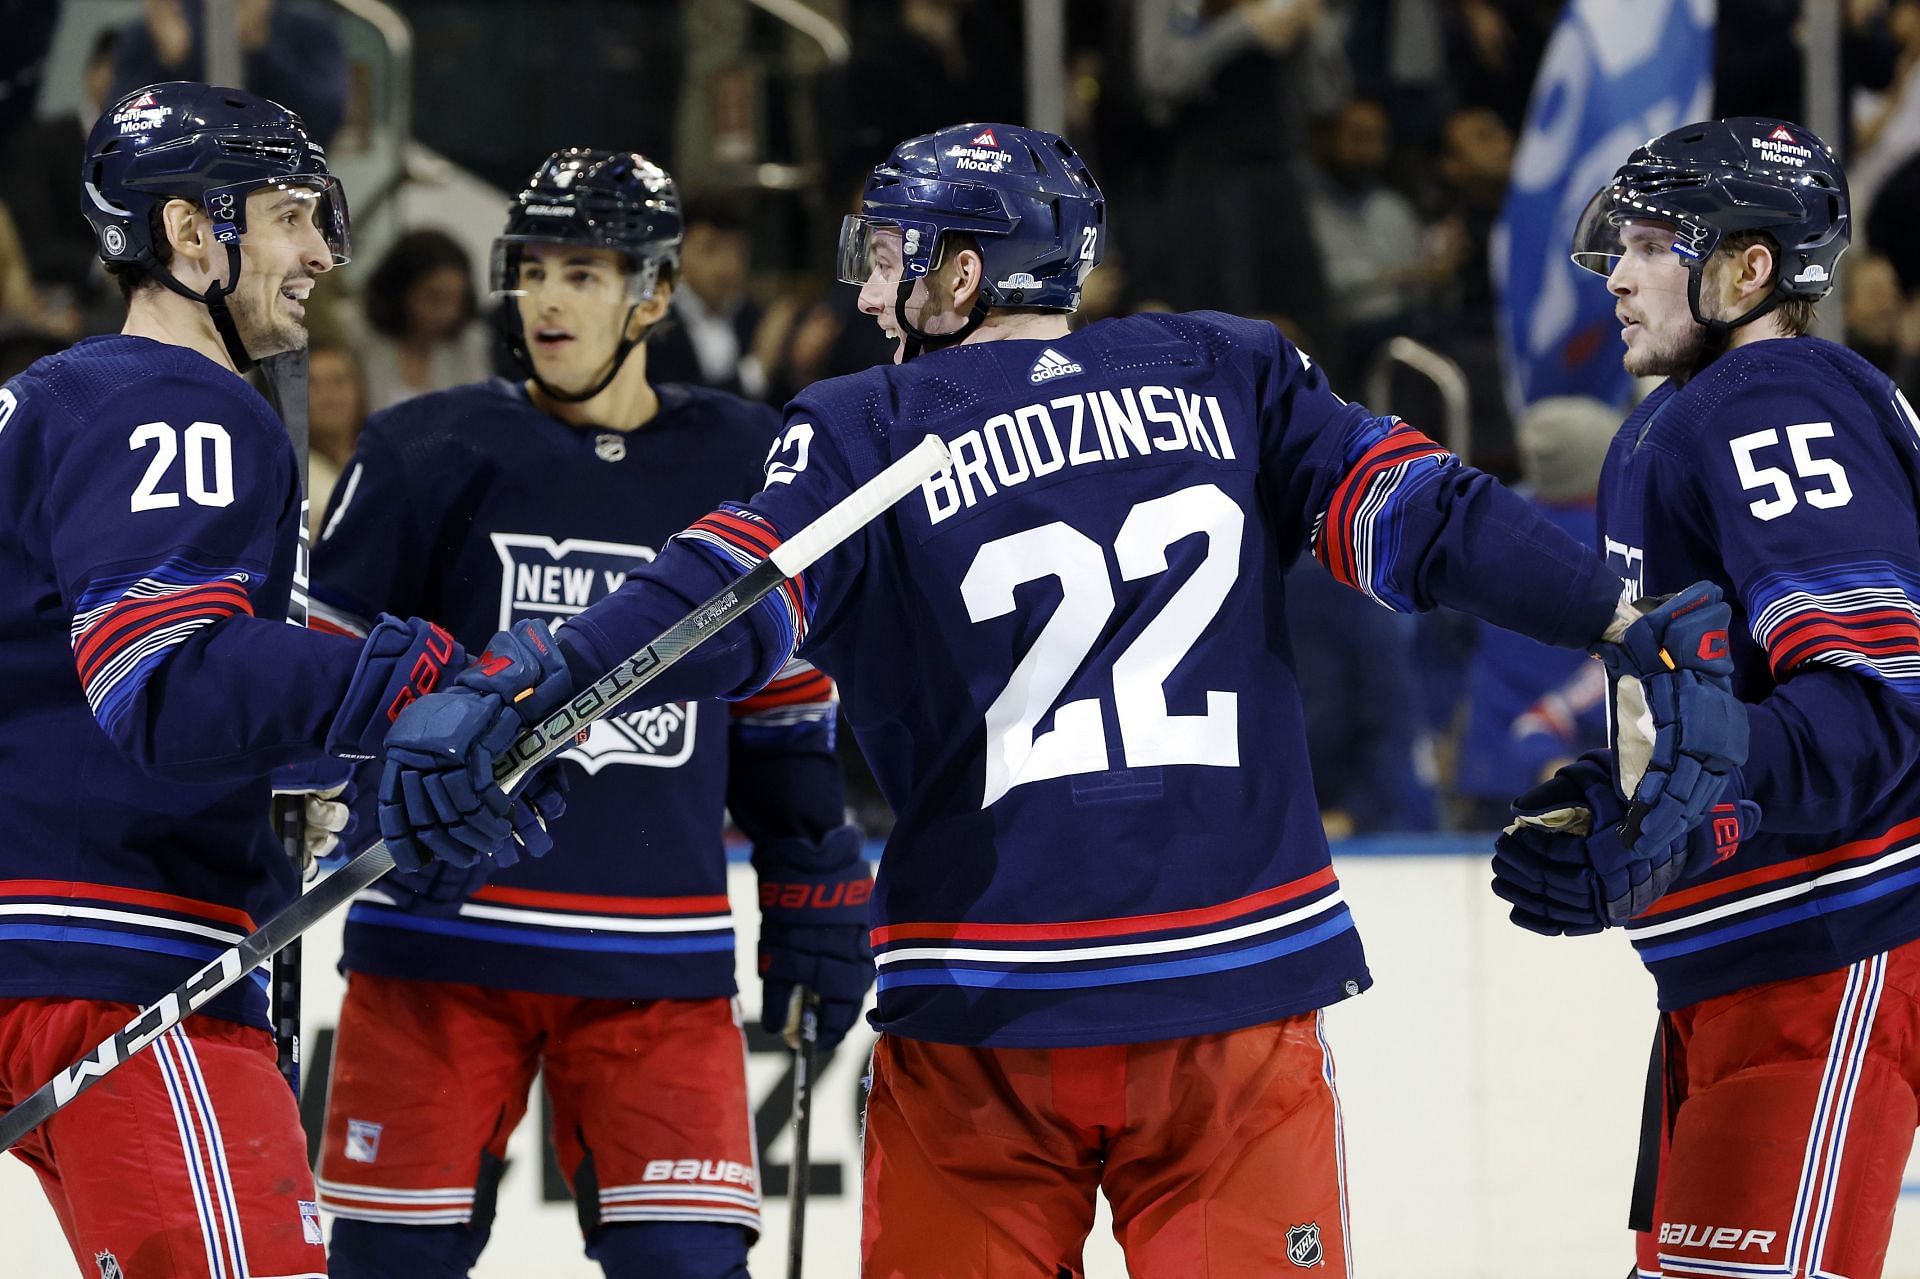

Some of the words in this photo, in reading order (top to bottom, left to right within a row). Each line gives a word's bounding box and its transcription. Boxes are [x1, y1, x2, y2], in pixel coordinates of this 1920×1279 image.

[113, 106, 173, 125] Benjamin
[120, 118, 163, 134] Moore
[950, 145, 1012, 163] Benjamin
[1751, 138, 1812, 159] Benjamin
[1760, 150, 1804, 167] Moore
[956, 158, 1001, 173] Moore
[1080, 226, 1097, 260] 22
[1031, 363, 1083, 382] adidas
[129, 421, 235, 513] 20
[922, 386, 1236, 525] BRODZINSKI
[1729, 422, 1853, 521] 55
[516, 562, 595, 606] NEW
[960, 483, 1245, 810] 22
[53, 947, 242, 1108] CCM
[1295, 1234, 1315, 1260] NHL
